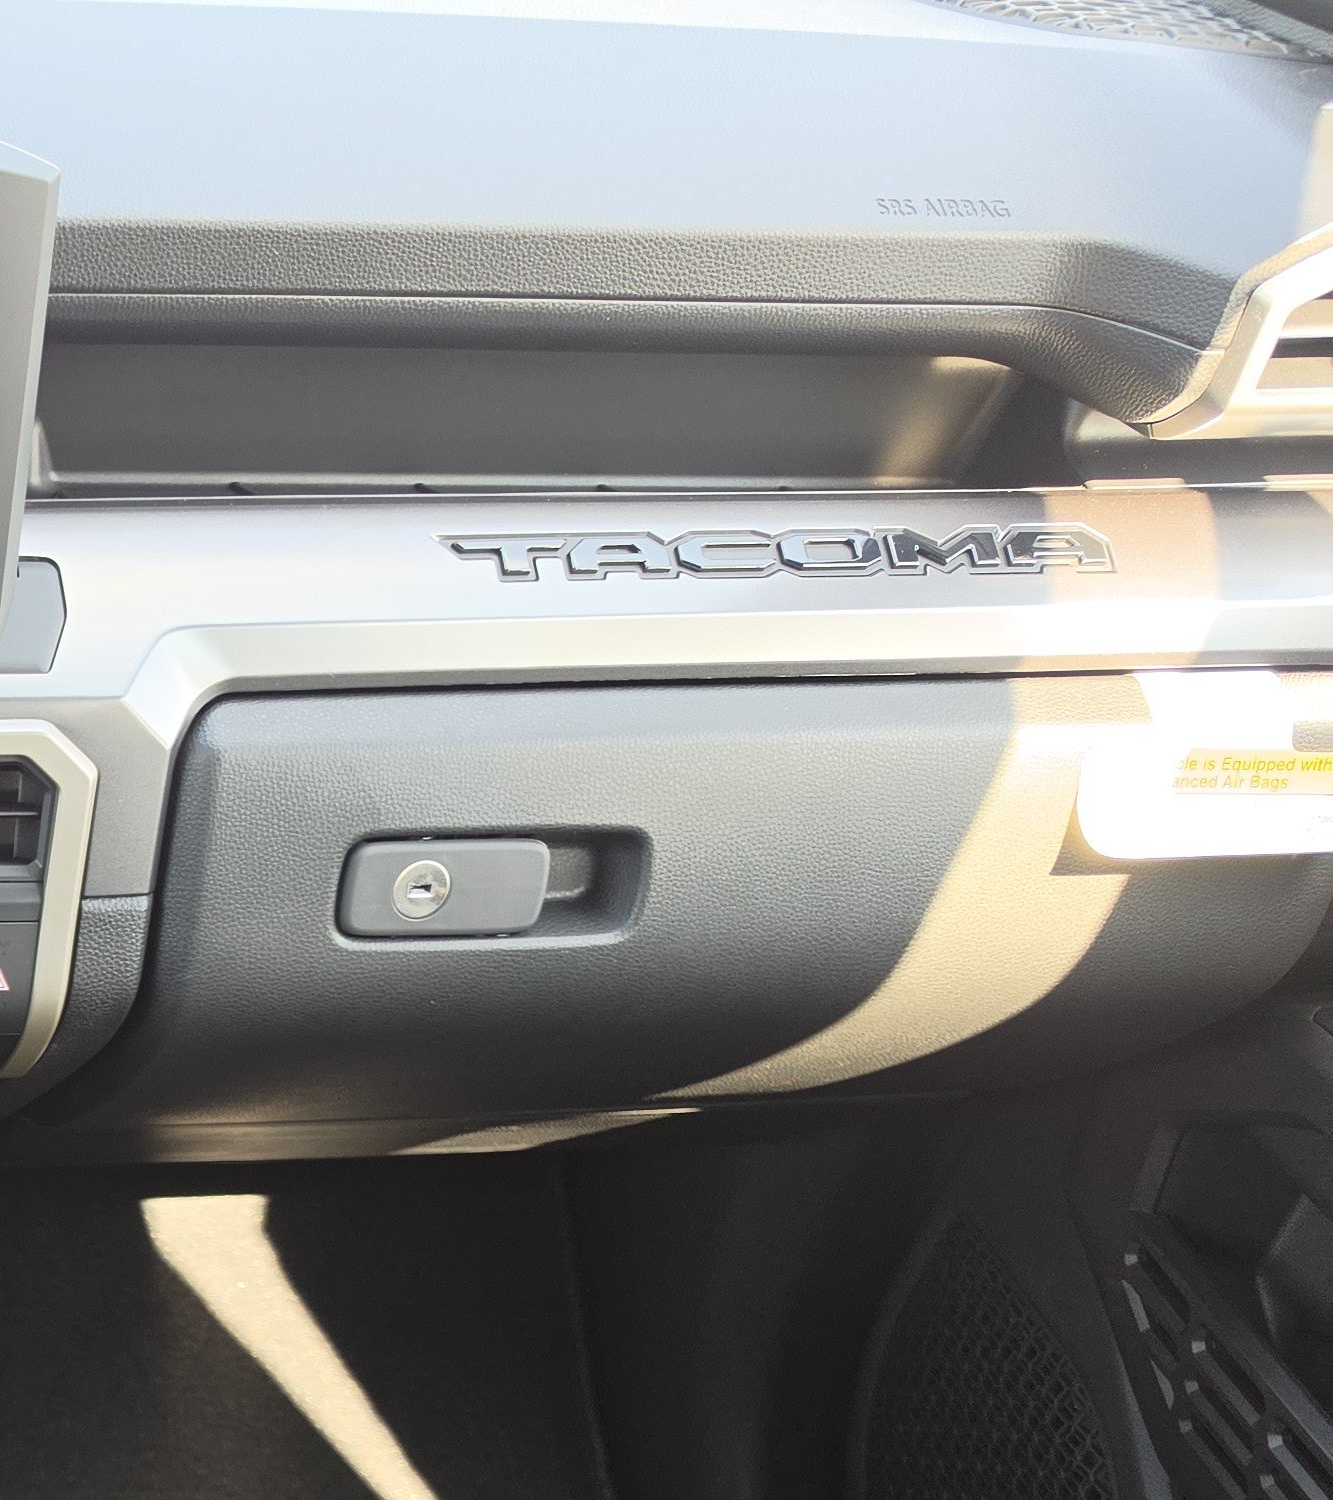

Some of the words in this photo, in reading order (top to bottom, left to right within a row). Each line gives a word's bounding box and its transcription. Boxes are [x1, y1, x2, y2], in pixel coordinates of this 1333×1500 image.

[876, 198, 917, 217] SRS
[926, 198, 1012, 219] AIRBAG
[431, 523, 1118, 583] TACOMA
[1204, 757, 1215, 770] is
[1222, 757, 1296, 773] Equipped
[1301, 757, 1333, 771] with
[1223, 775, 1245, 788] Air
[1250, 775, 1289, 792] Bags
